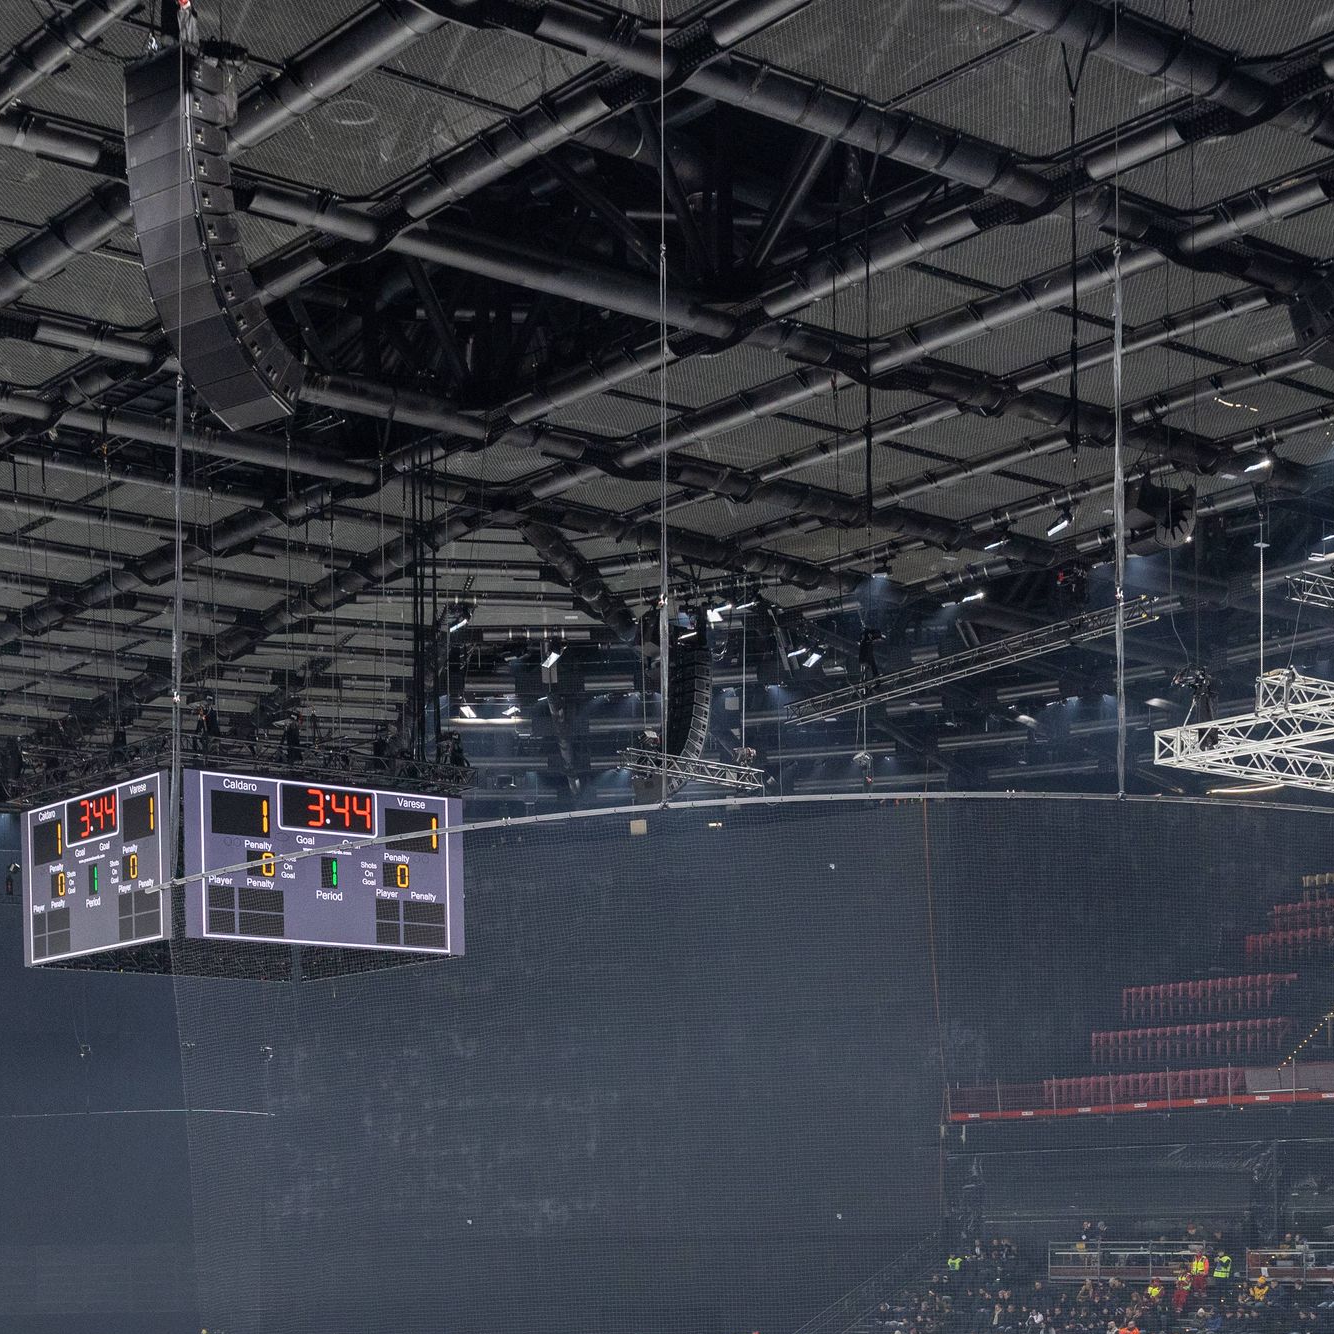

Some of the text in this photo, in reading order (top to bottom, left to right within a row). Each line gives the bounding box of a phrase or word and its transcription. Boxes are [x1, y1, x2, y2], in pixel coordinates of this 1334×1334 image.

[129, 783, 147, 795] Varese
[223, 779, 257, 792] Caldaro
[307, 788, 371, 829] 3:44
[397, 798, 426, 810] Varese
[39, 810, 55, 822] Caldaro
[79, 794, 116, 838] 3:44
[149, 797, 154, 830] 1
[262, 800, 268, 833] 1
[57, 823, 62, 855] 1
[296, 835, 315, 845] Goal
[75, 841, 110, 858] Goal Goal
[123, 844, 138, 854] Penalty
[245, 840, 273, 852] Penalty
[383, 852, 410, 864] Penalty
[49, 863, 63, 874] Penalty
[361, 861, 377, 870] Shots
[281, 871, 295, 879] Goal
[365, 870, 373, 878] On
[397, 864, 409, 888] 0
[209, 875, 233, 886] Player
[247, 878, 275, 889] Penalty
[362, 878, 377, 886] Goal
[315, 890, 343, 902] Period
[376, 888, 399, 899] Player
[411, 892, 437, 903] Penalty
[51, 899, 65, 909] Penalty
[85, 896, 101, 908] Period
